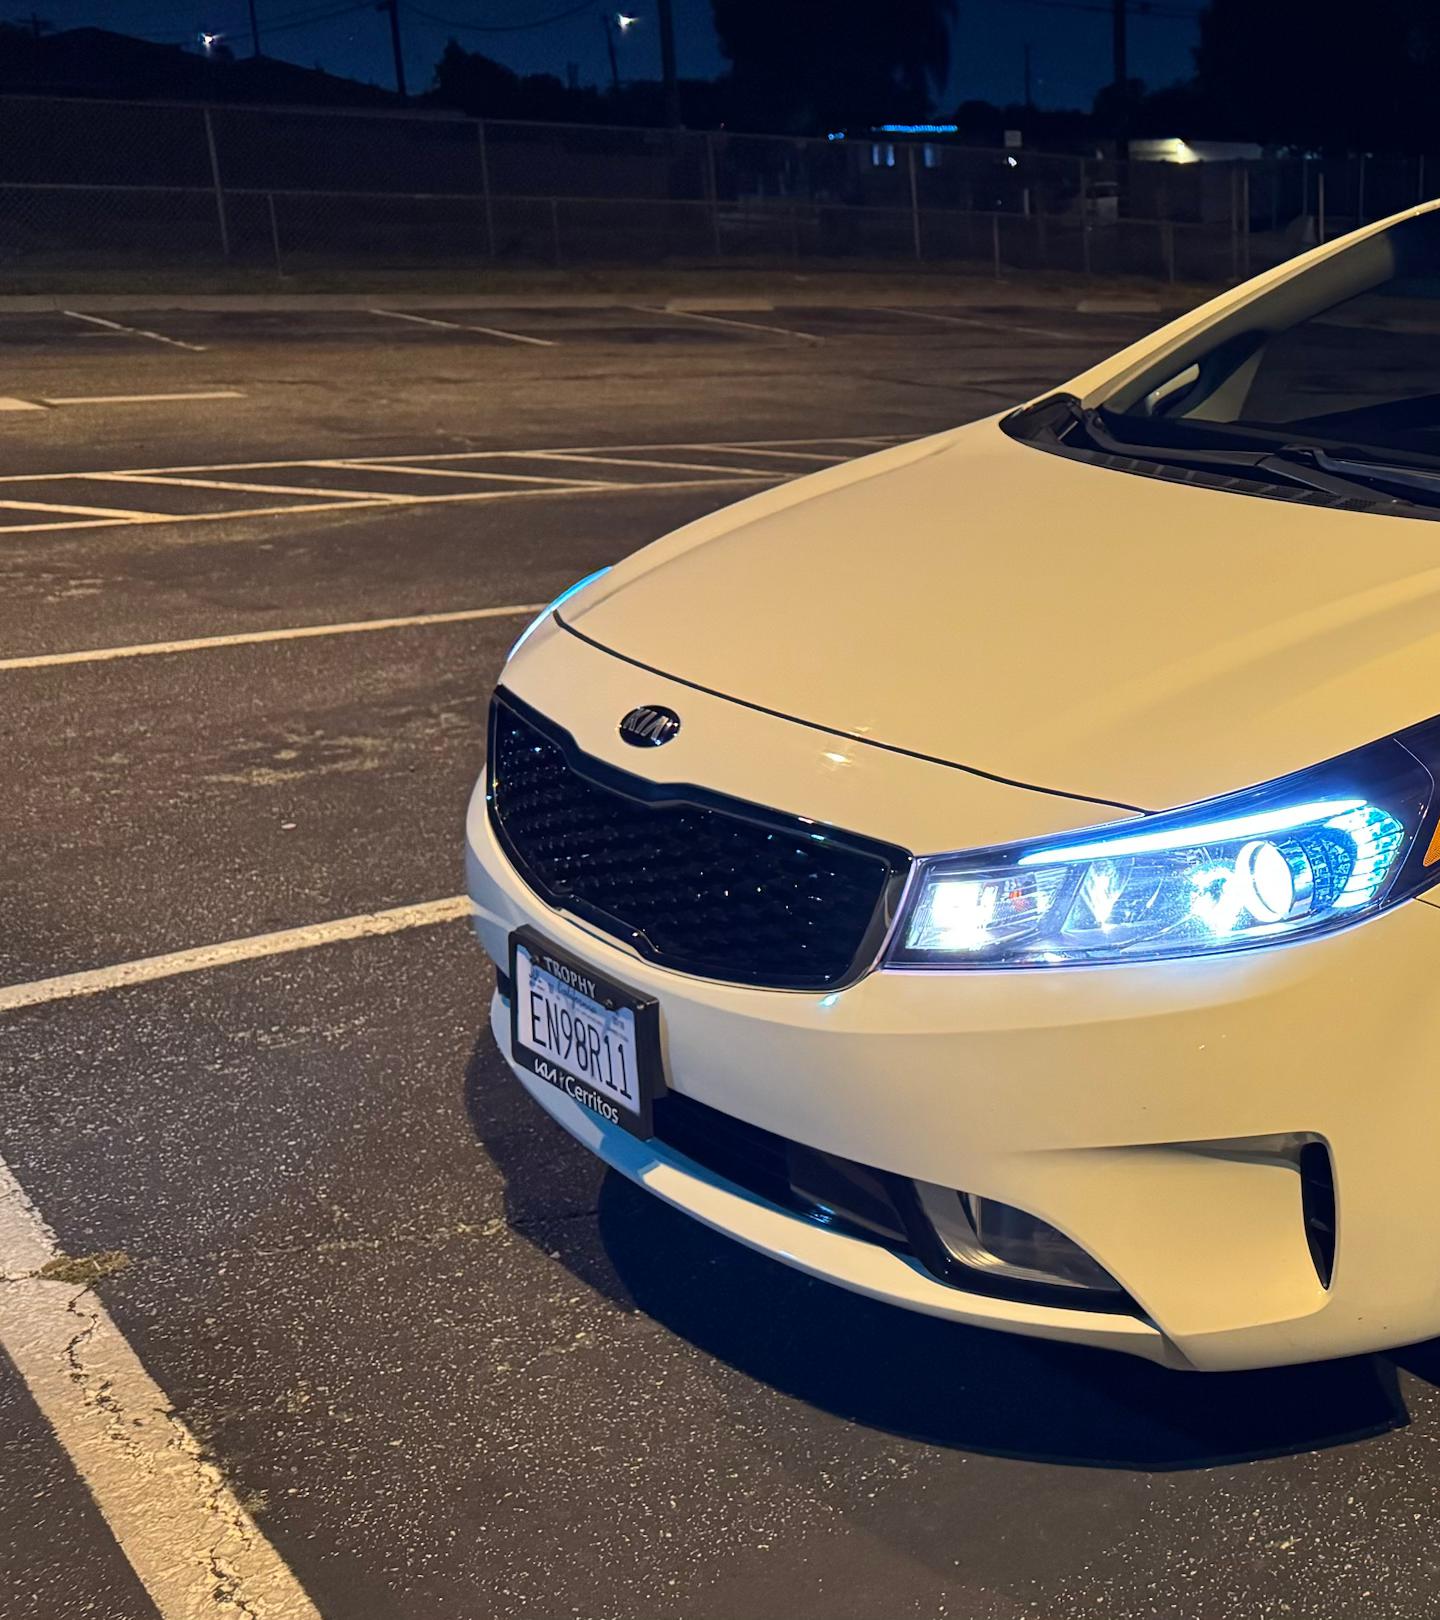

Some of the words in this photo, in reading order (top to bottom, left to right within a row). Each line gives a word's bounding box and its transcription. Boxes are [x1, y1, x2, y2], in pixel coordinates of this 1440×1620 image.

[622, 708, 669, 741] KIA
[543, 956, 597, 998] TROPHY
[530, 991, 632, 1100] EN98R11
[565, 1076, 619, 1125] Cerritos
